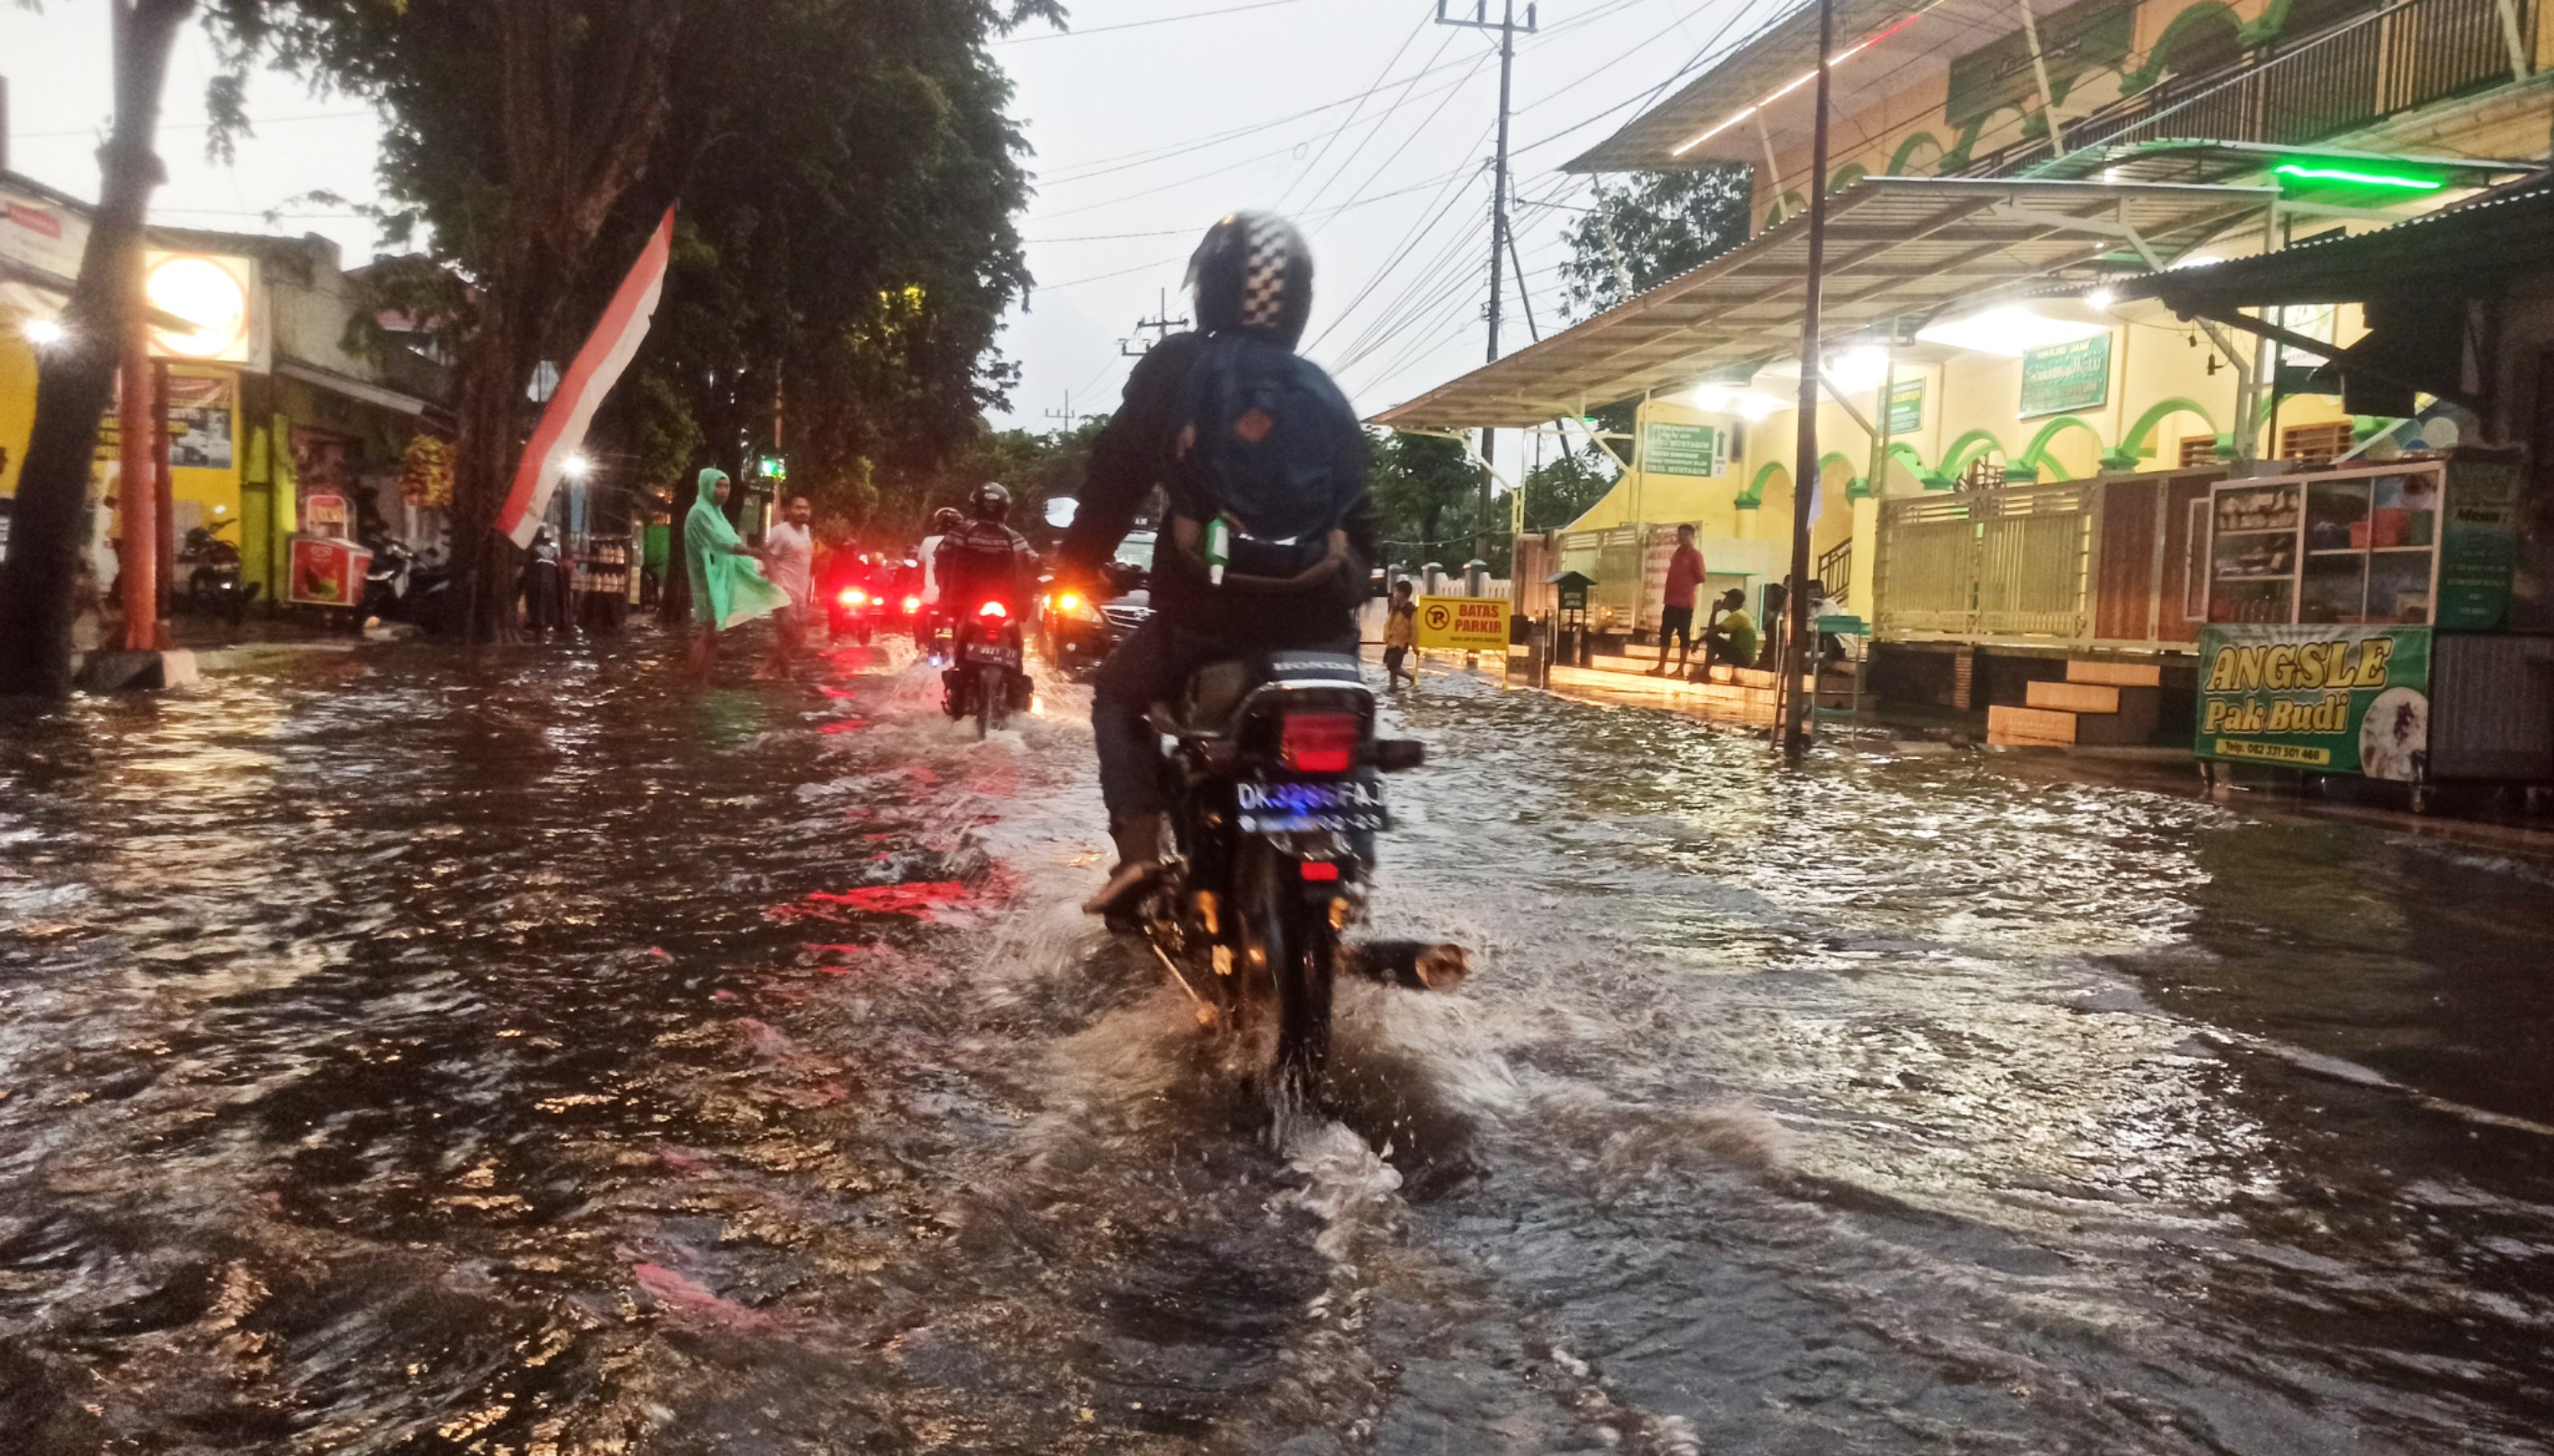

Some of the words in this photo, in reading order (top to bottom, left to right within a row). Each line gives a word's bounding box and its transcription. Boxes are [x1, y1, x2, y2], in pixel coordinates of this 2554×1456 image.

[1459, 604, 1499, 618] BATAS
[1455, 620, 1502, 634] PARKIR
[2205, 637, 2393, 692] ANGSLE
[2203, 696, 2264, 734] Pak
[2264, 692, 2349, 734] Budi
[2247, 744, 2264, 755] 082
[2283, 746, 2299, 758] 501
